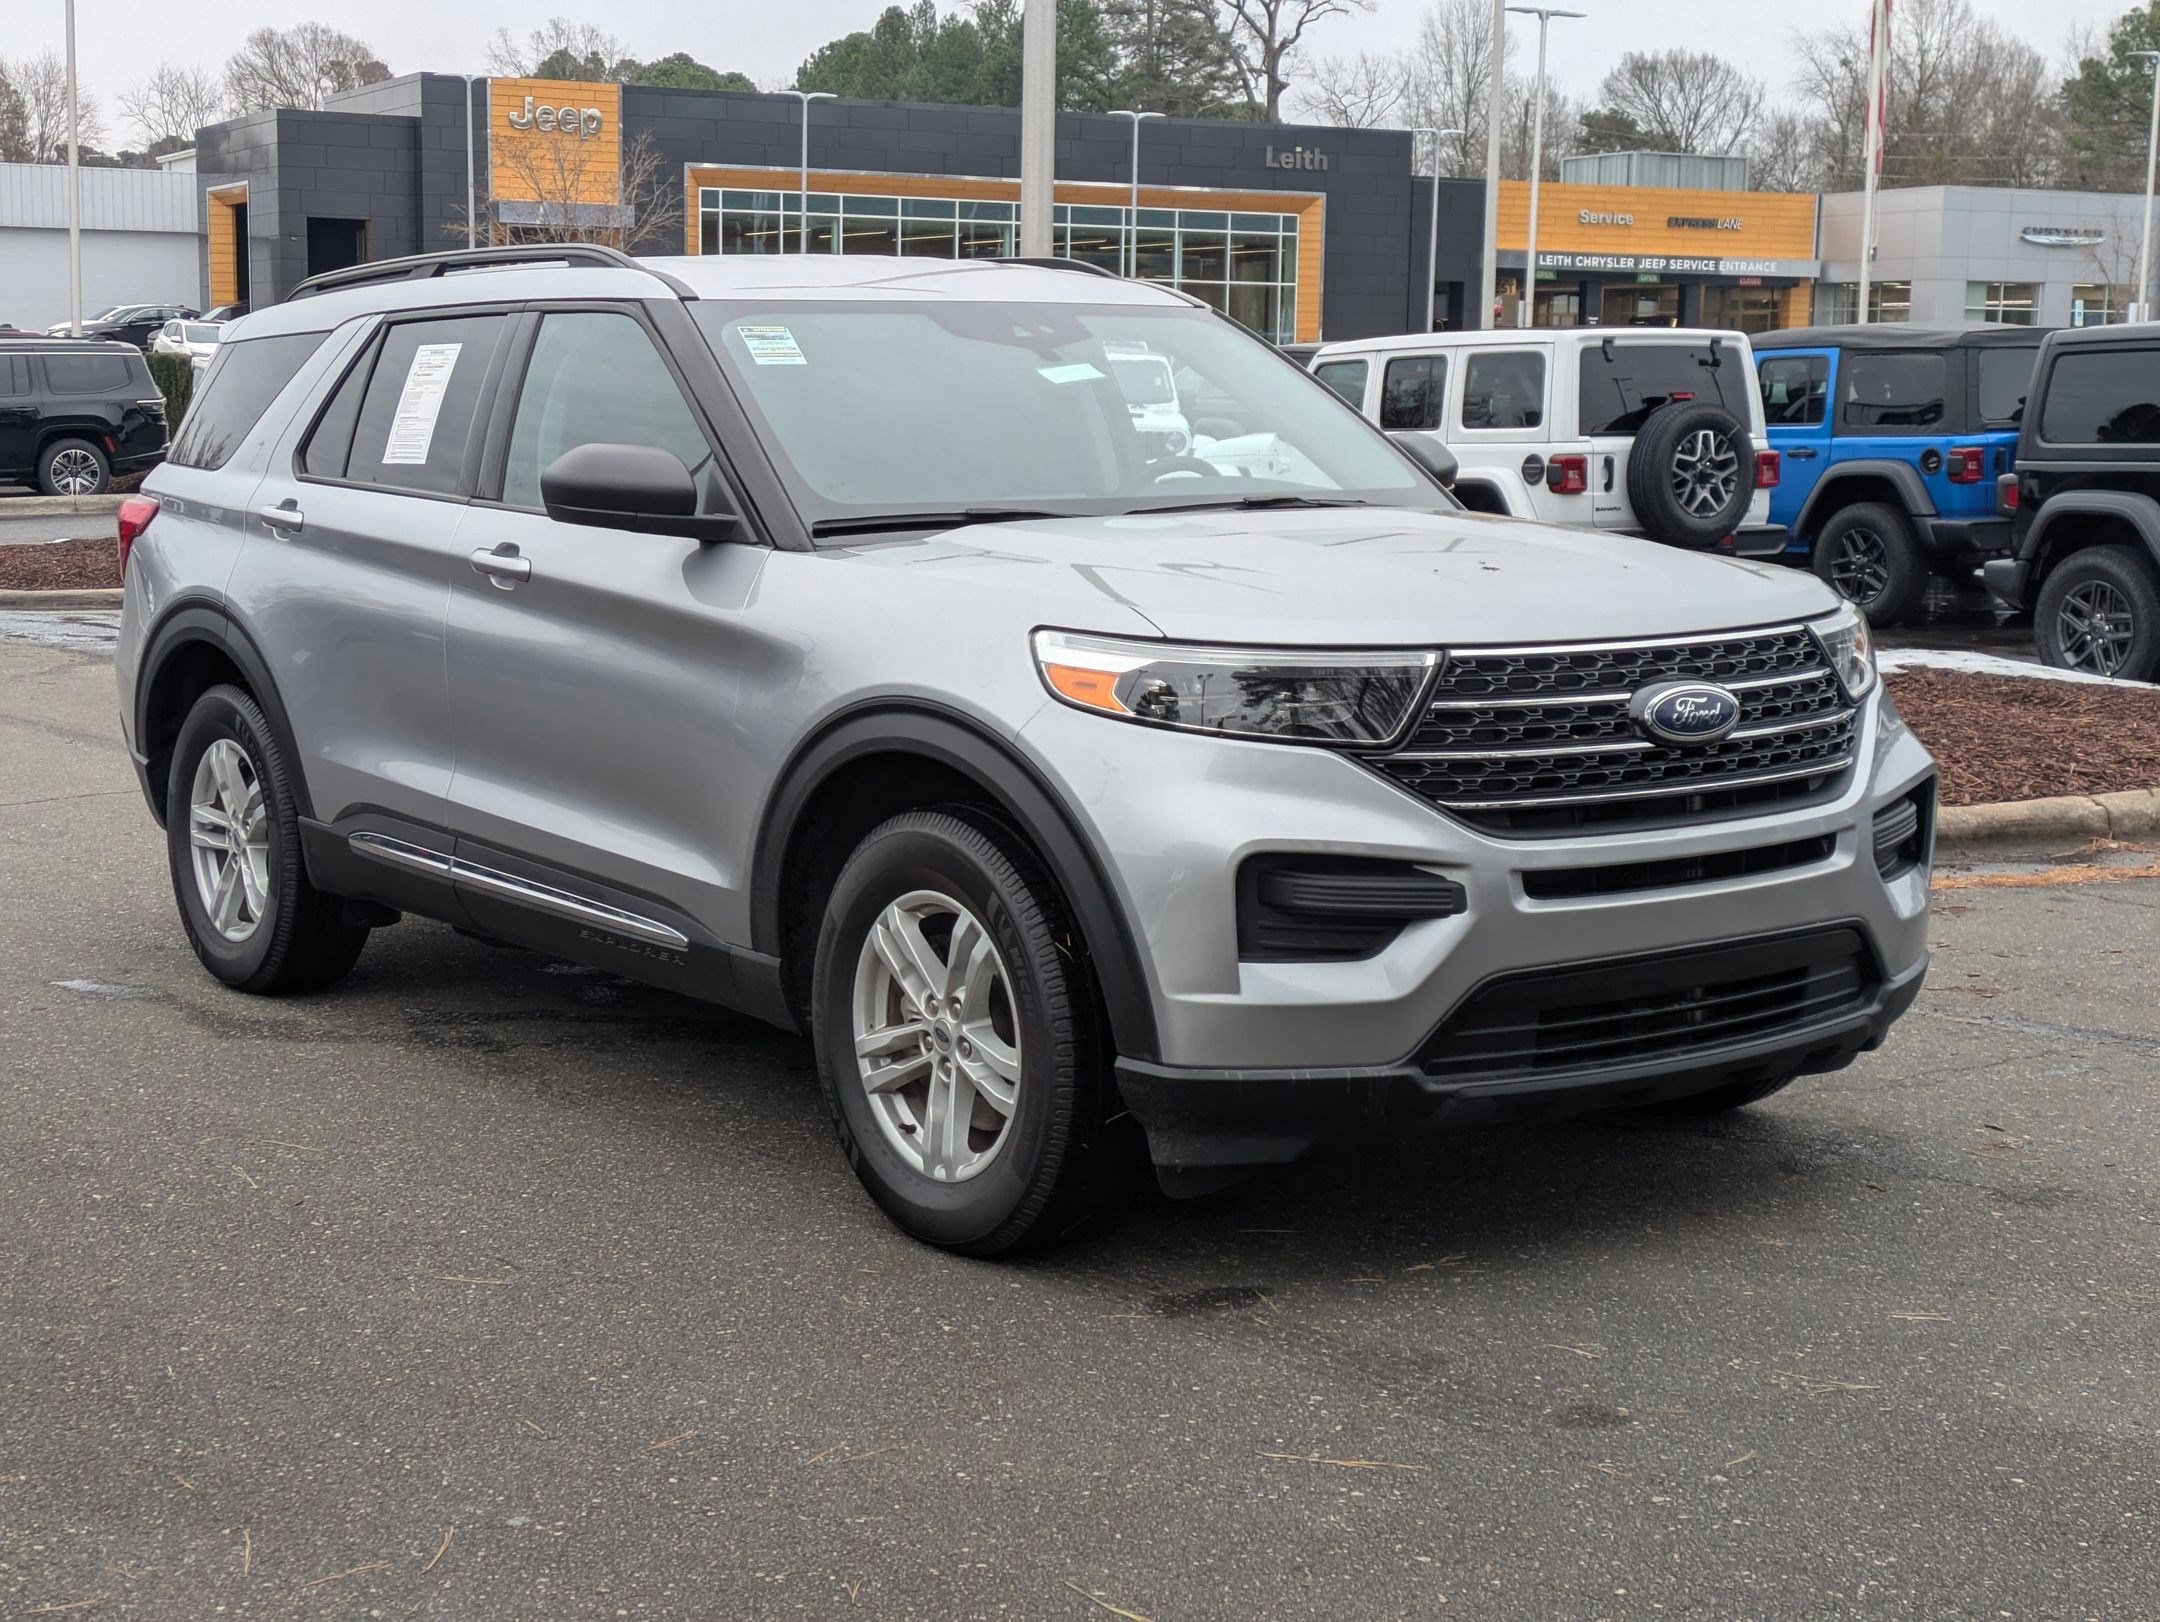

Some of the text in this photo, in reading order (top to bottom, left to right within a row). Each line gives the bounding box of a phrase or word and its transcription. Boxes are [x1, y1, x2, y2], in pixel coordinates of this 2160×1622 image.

[509, 96, 603, 140] Jeep
[1265, 144, 1329, 170] Leith
[1579, 209, 1633, 225] Service
[1536, 270, 1554, 279] OPEN
[1539, 254, 1777, 273] LEITH CHRYSLER JEEP SERVICE ENTRANCE
[1672, 696, 1722, 726] Ford
